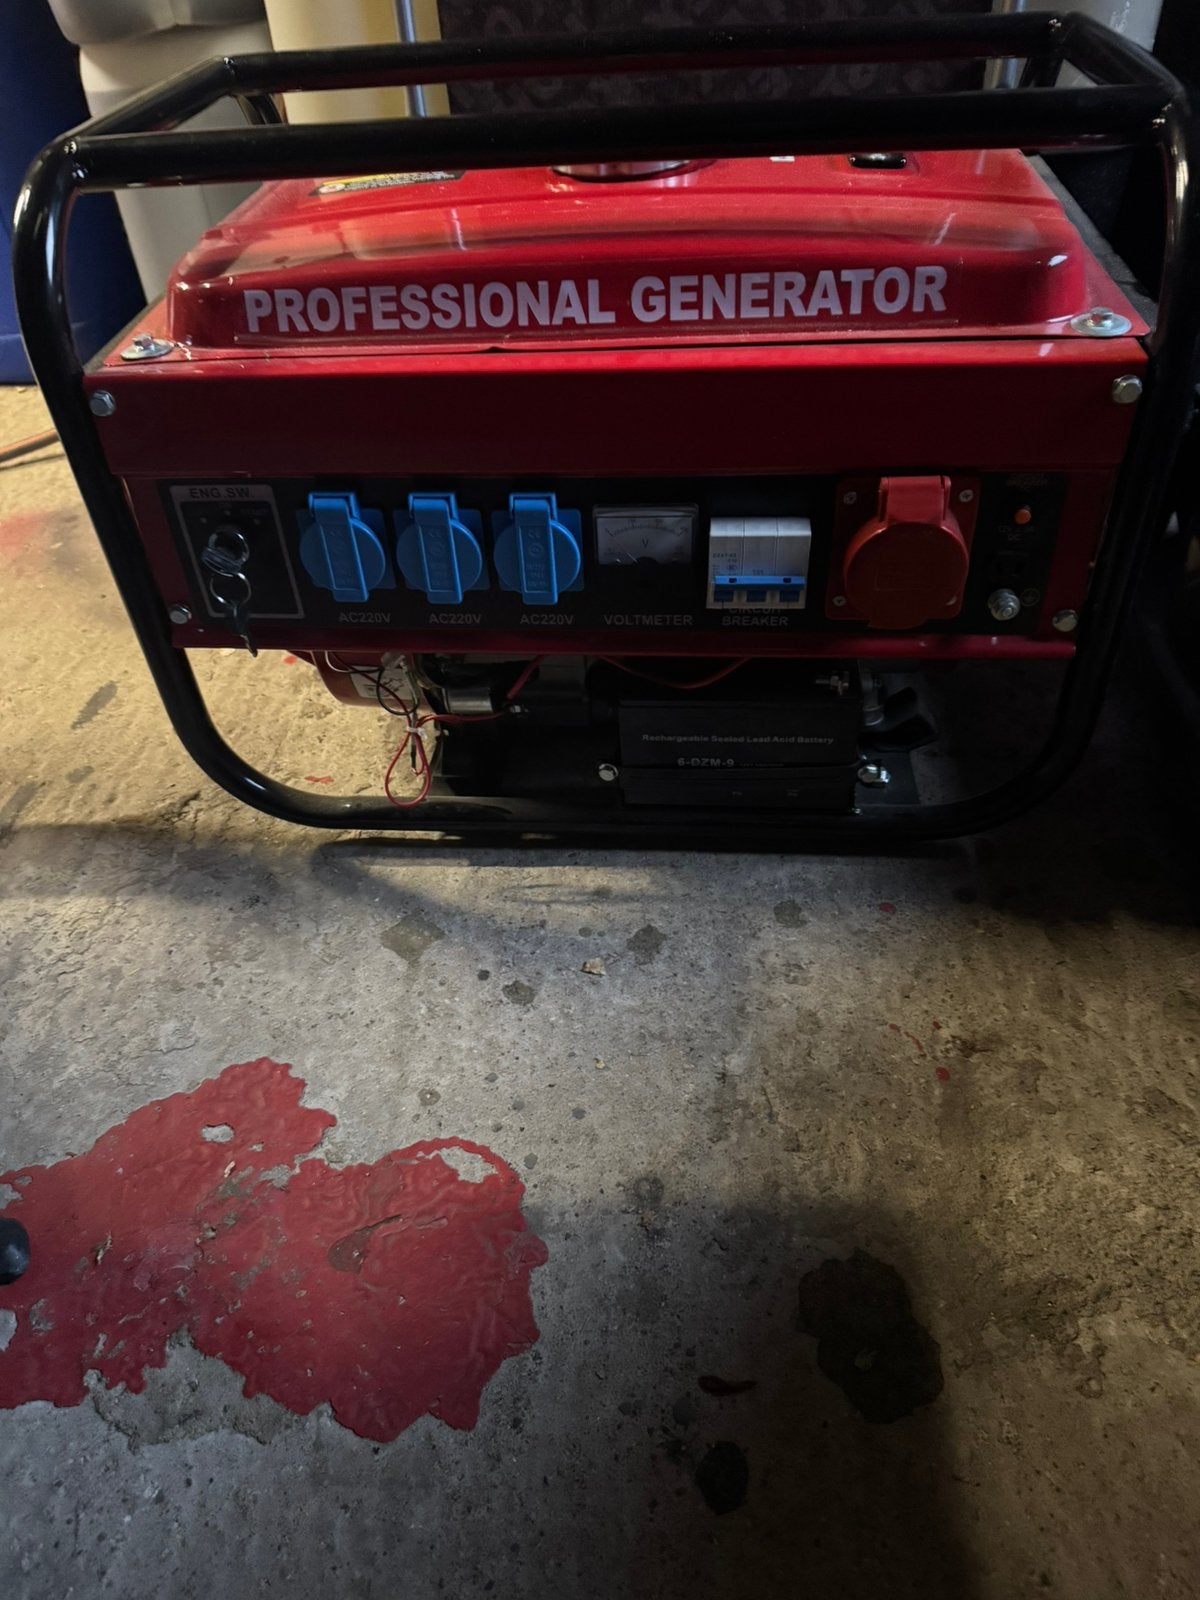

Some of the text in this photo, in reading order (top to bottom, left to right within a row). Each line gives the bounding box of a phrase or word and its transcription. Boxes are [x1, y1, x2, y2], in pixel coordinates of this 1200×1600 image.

[243, 266, 947, 332] PROFESSIONAL GENERATOR
[338, 612, 391, 623] AC220V
[428, 613, 482, 624] AC220V
[520, 614, 574, 625] AC220V
[603, 614, 693, 627] VOLTMETER
[721, 615, 789, 627] BREAKER
[641, 734, 834, 745] Rechargeable Sealed Lead Acid Battery
[676, 757, 736, 768] 6-DZM-9
